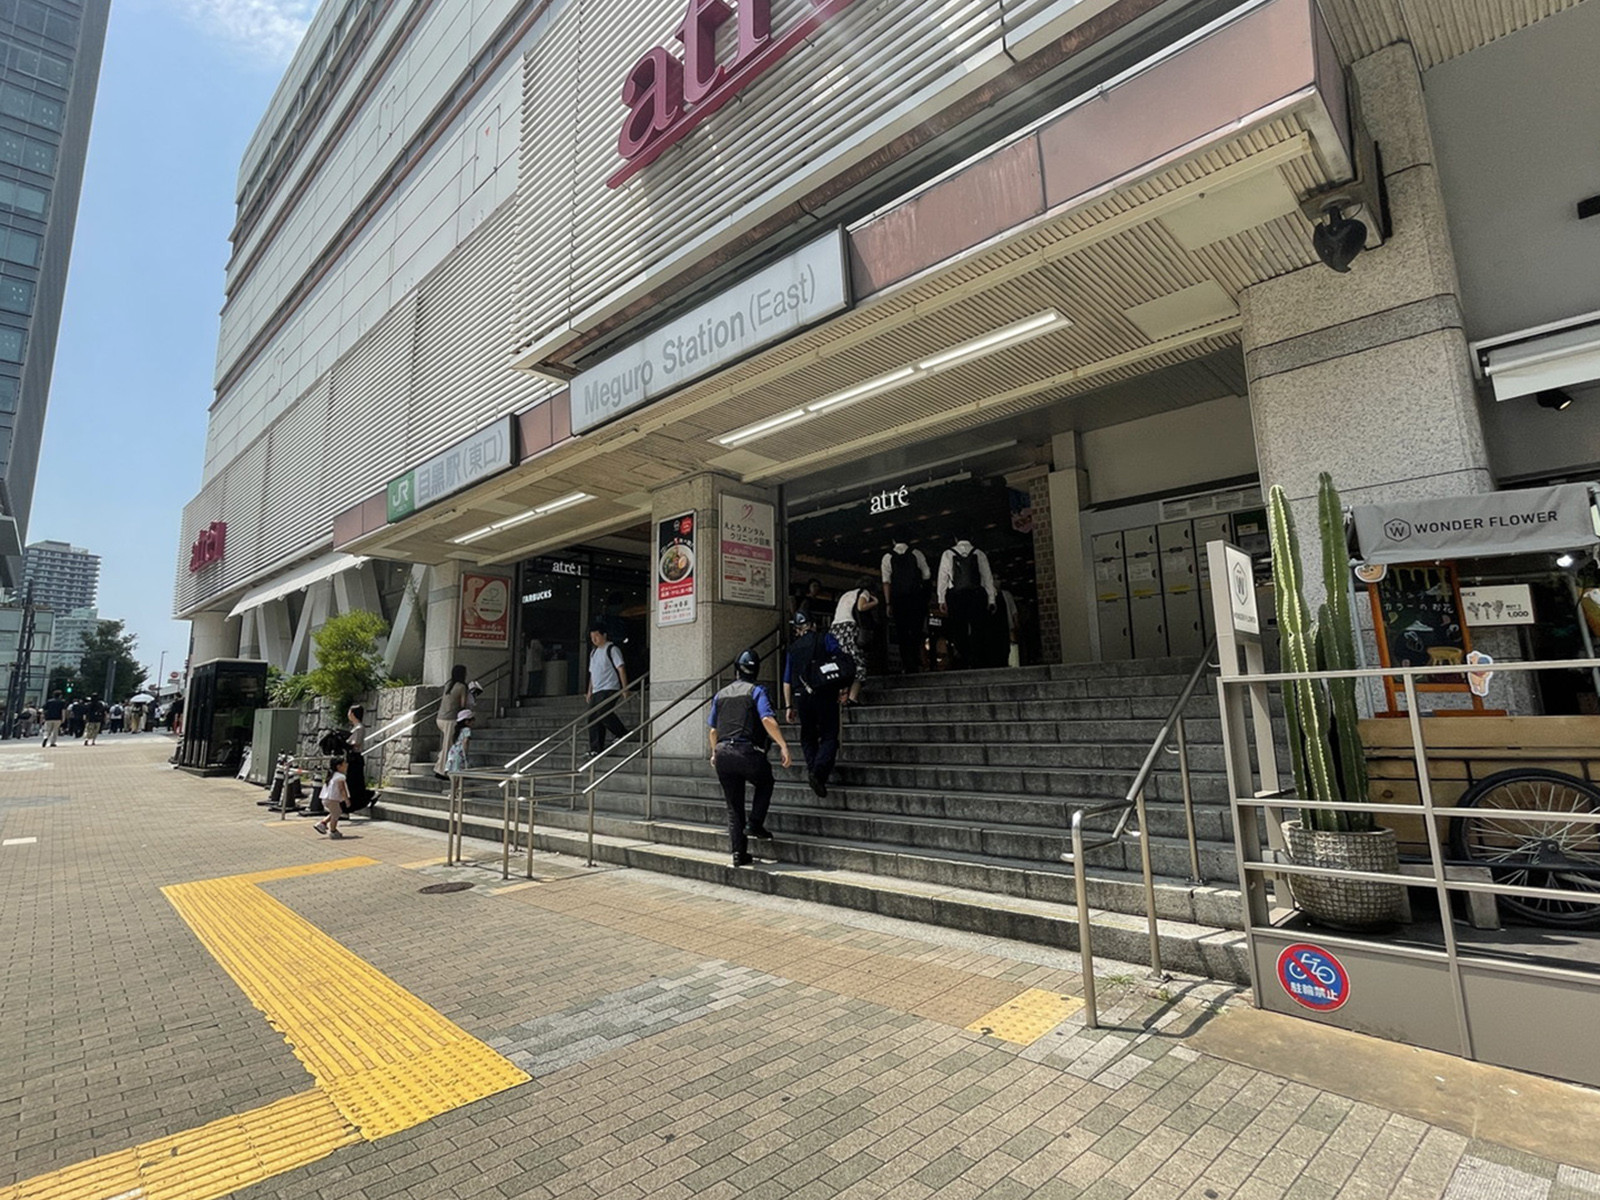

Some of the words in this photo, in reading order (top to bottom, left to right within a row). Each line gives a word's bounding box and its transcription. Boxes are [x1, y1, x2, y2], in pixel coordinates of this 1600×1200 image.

[584, 360, 654, 416] Meguro
[662, 311, 746, 375] Station
[749, 263, 816, 332] (East)
[392, 479, 410, 508] JR
[869, 484, 910, 514] atré
[1414, 518, 1484, 534] WONDER
[1489, 510, 1558, 527] FLOWER
[1290, 981, 1339, 1002] 駐輪禁止
